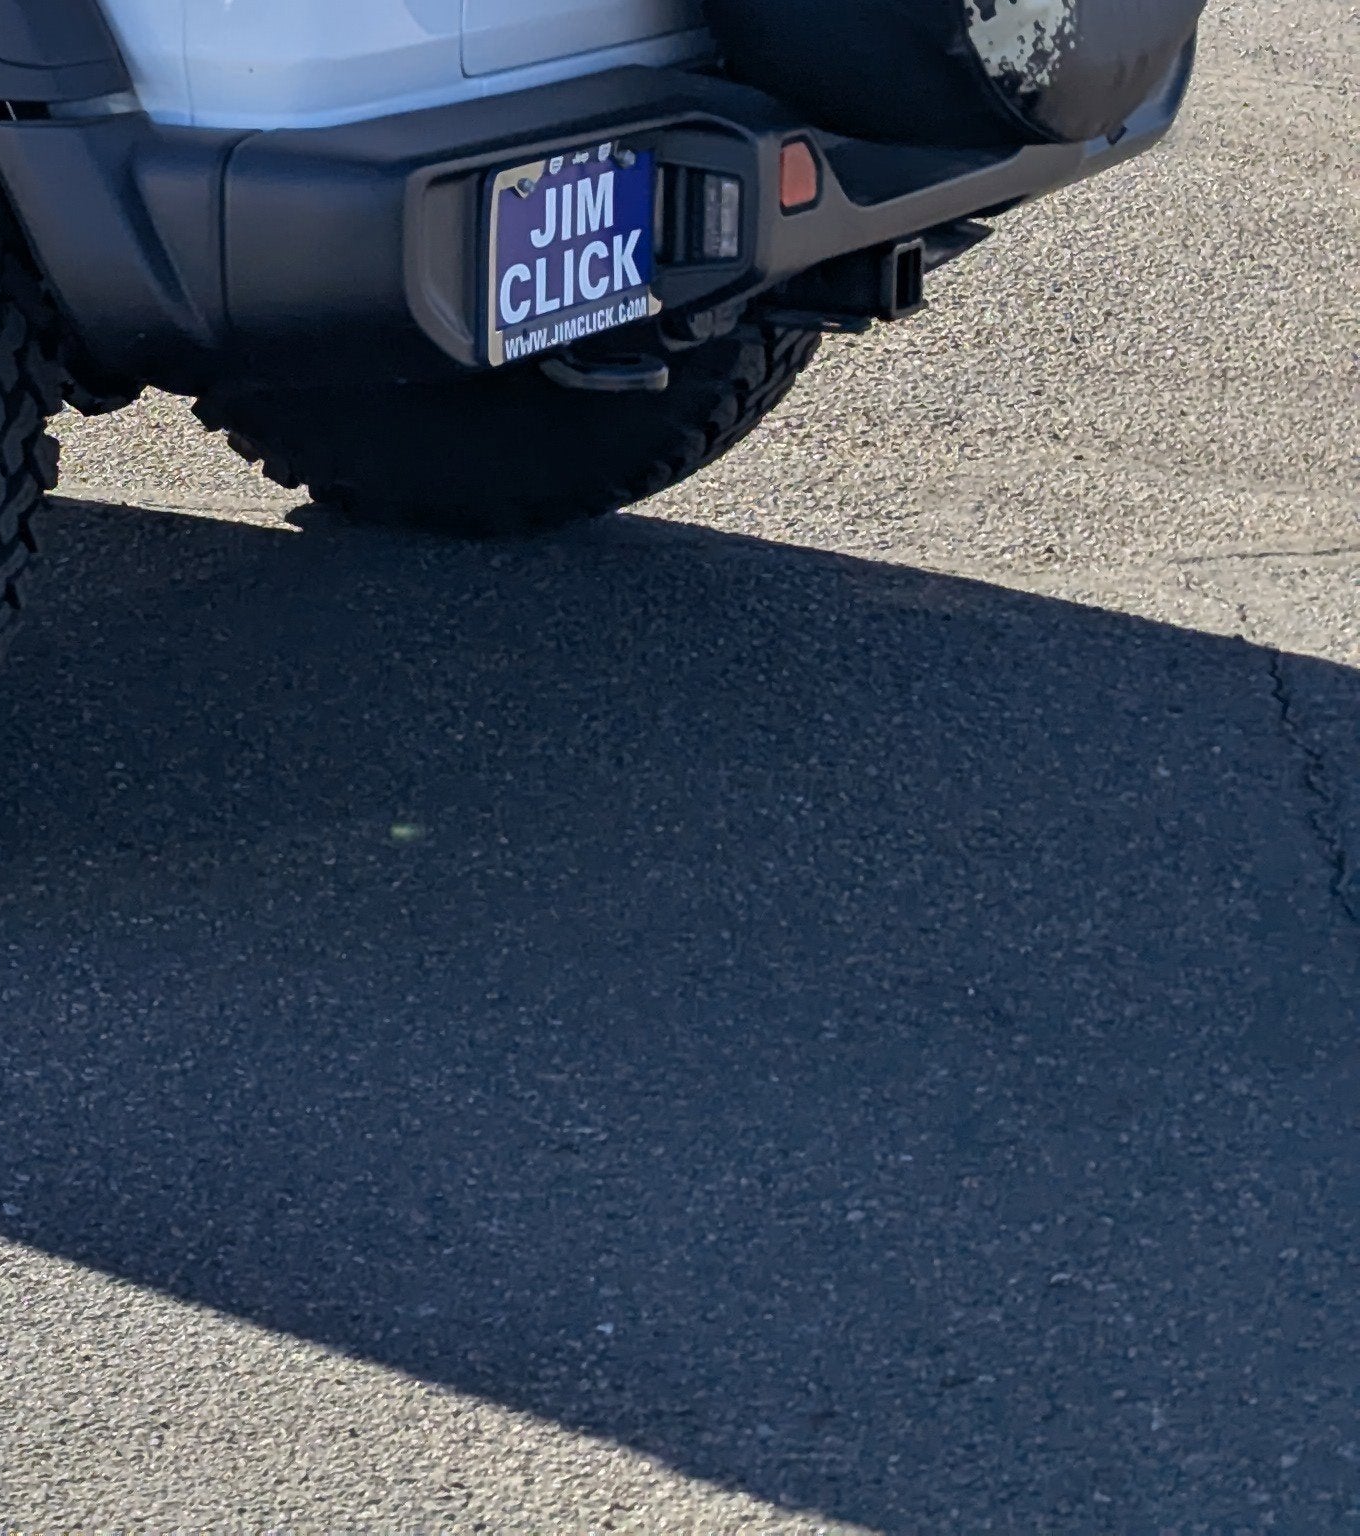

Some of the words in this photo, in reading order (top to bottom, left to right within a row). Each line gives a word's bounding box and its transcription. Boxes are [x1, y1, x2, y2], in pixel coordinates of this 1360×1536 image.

[530, 170, 615, 249] JIM
[499, 228, 643, 325] CLICK
[504, 295, 648, 361] WWW.JIMCLICK.COM
